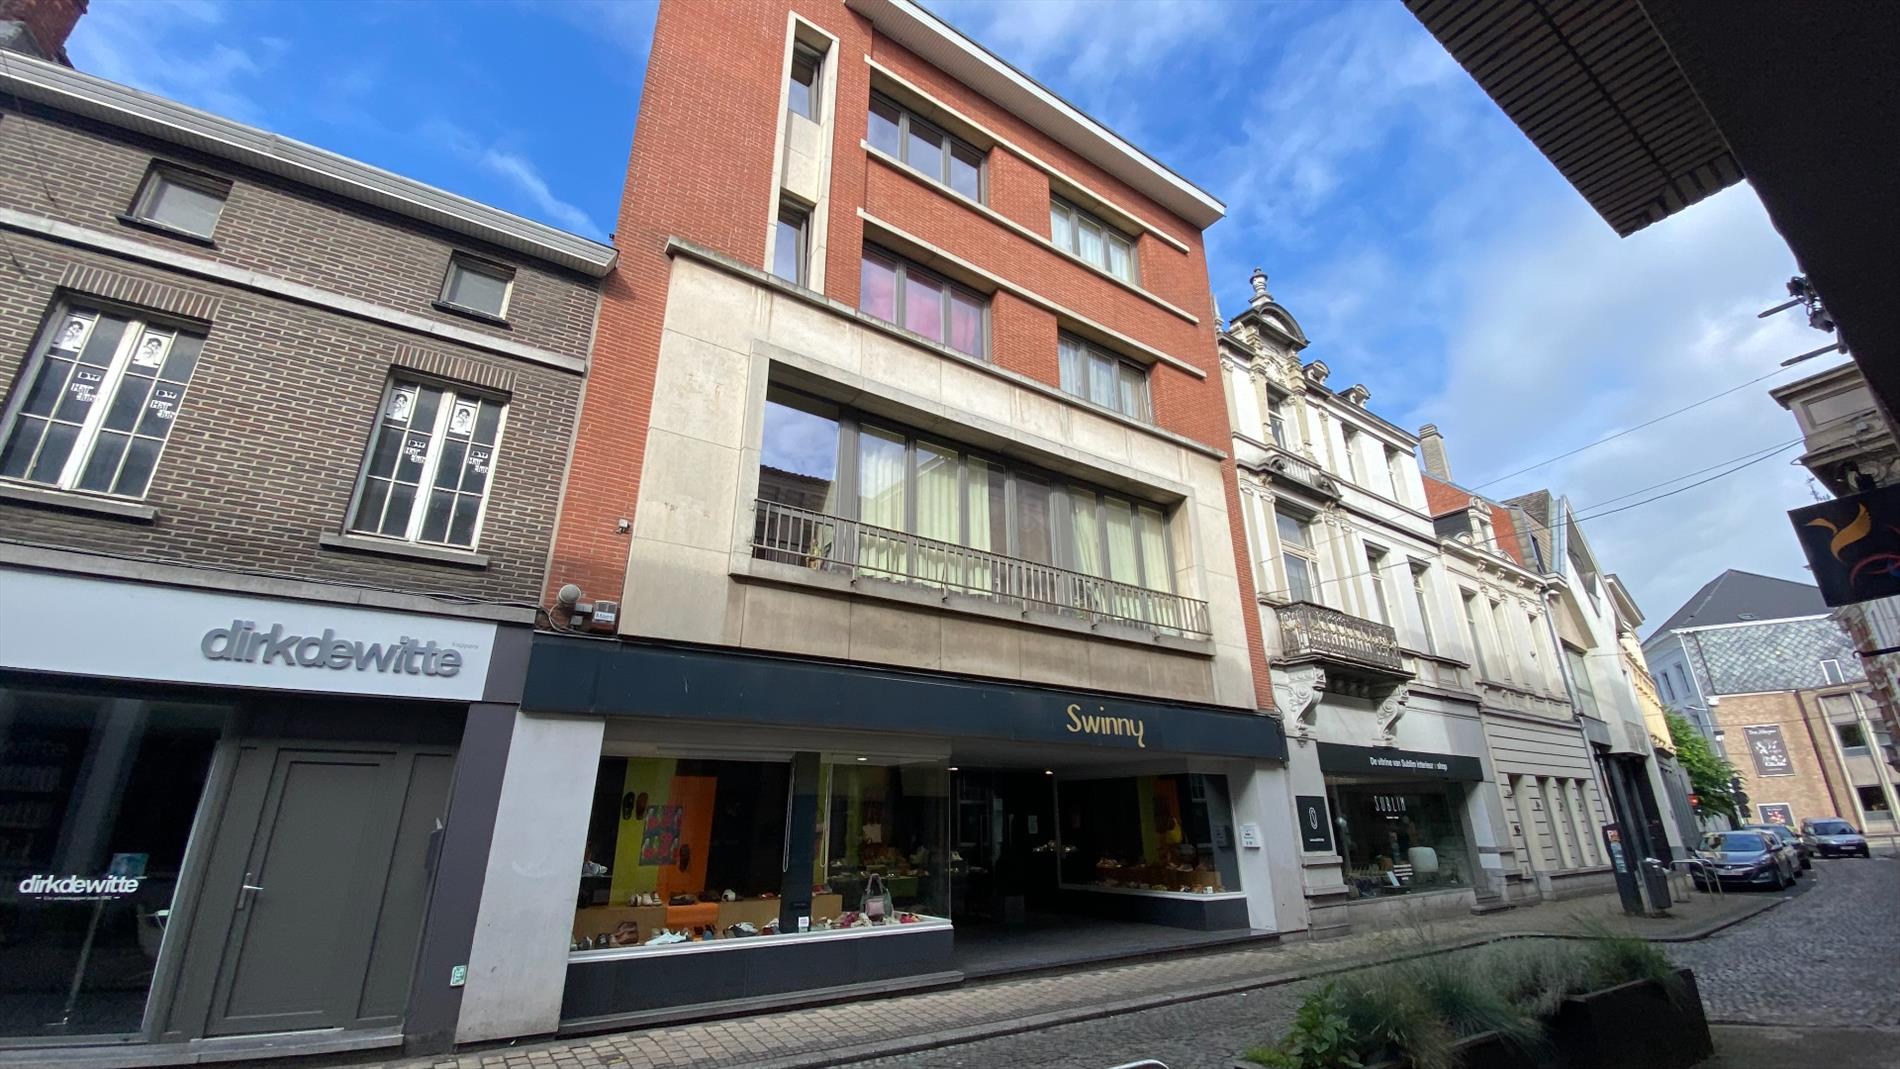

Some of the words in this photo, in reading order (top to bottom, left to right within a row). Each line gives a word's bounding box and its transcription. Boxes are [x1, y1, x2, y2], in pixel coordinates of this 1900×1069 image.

[201, 619, 463, 677] dirkdewitte
[1066, 703, 1145, 748] Swinny
[1369, 756, 1377, 765] De
[18, 874, 140, 894] dirkdewitte
